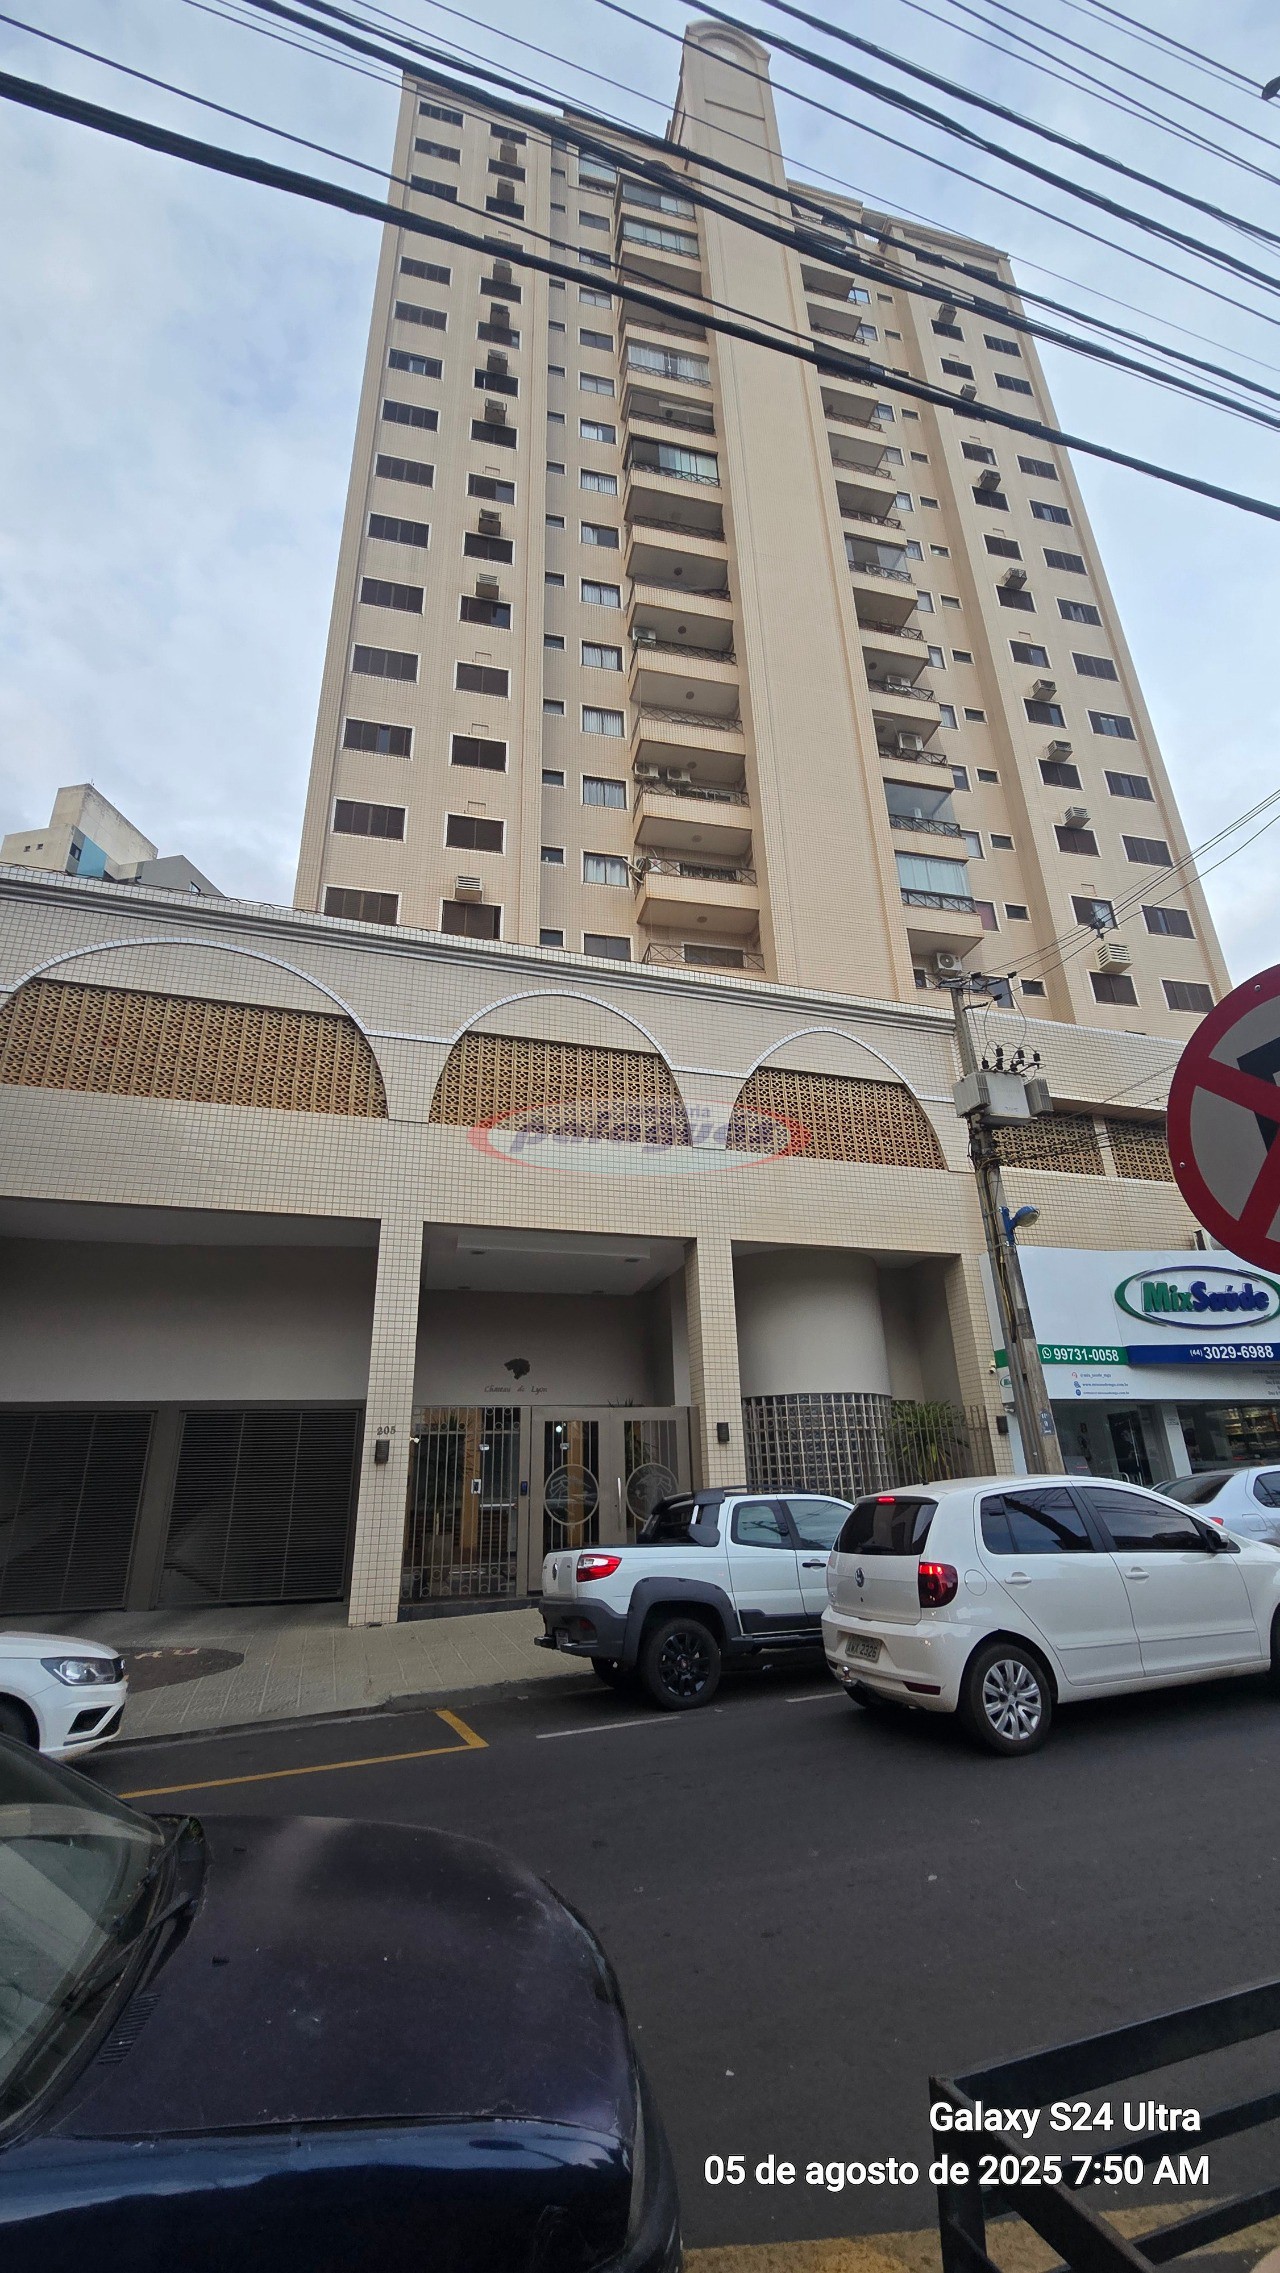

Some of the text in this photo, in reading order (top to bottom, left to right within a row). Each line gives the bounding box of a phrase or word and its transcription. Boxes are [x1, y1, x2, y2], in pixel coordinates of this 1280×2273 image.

[1142, 1281, 1270, 1312] MixSaúde
[1053, 1347, 1119, 1361] 99731-0058
[1190, 1345, 1274, 1359] (44) 3029-6988
[376, 1425, 396, 1436] 205
